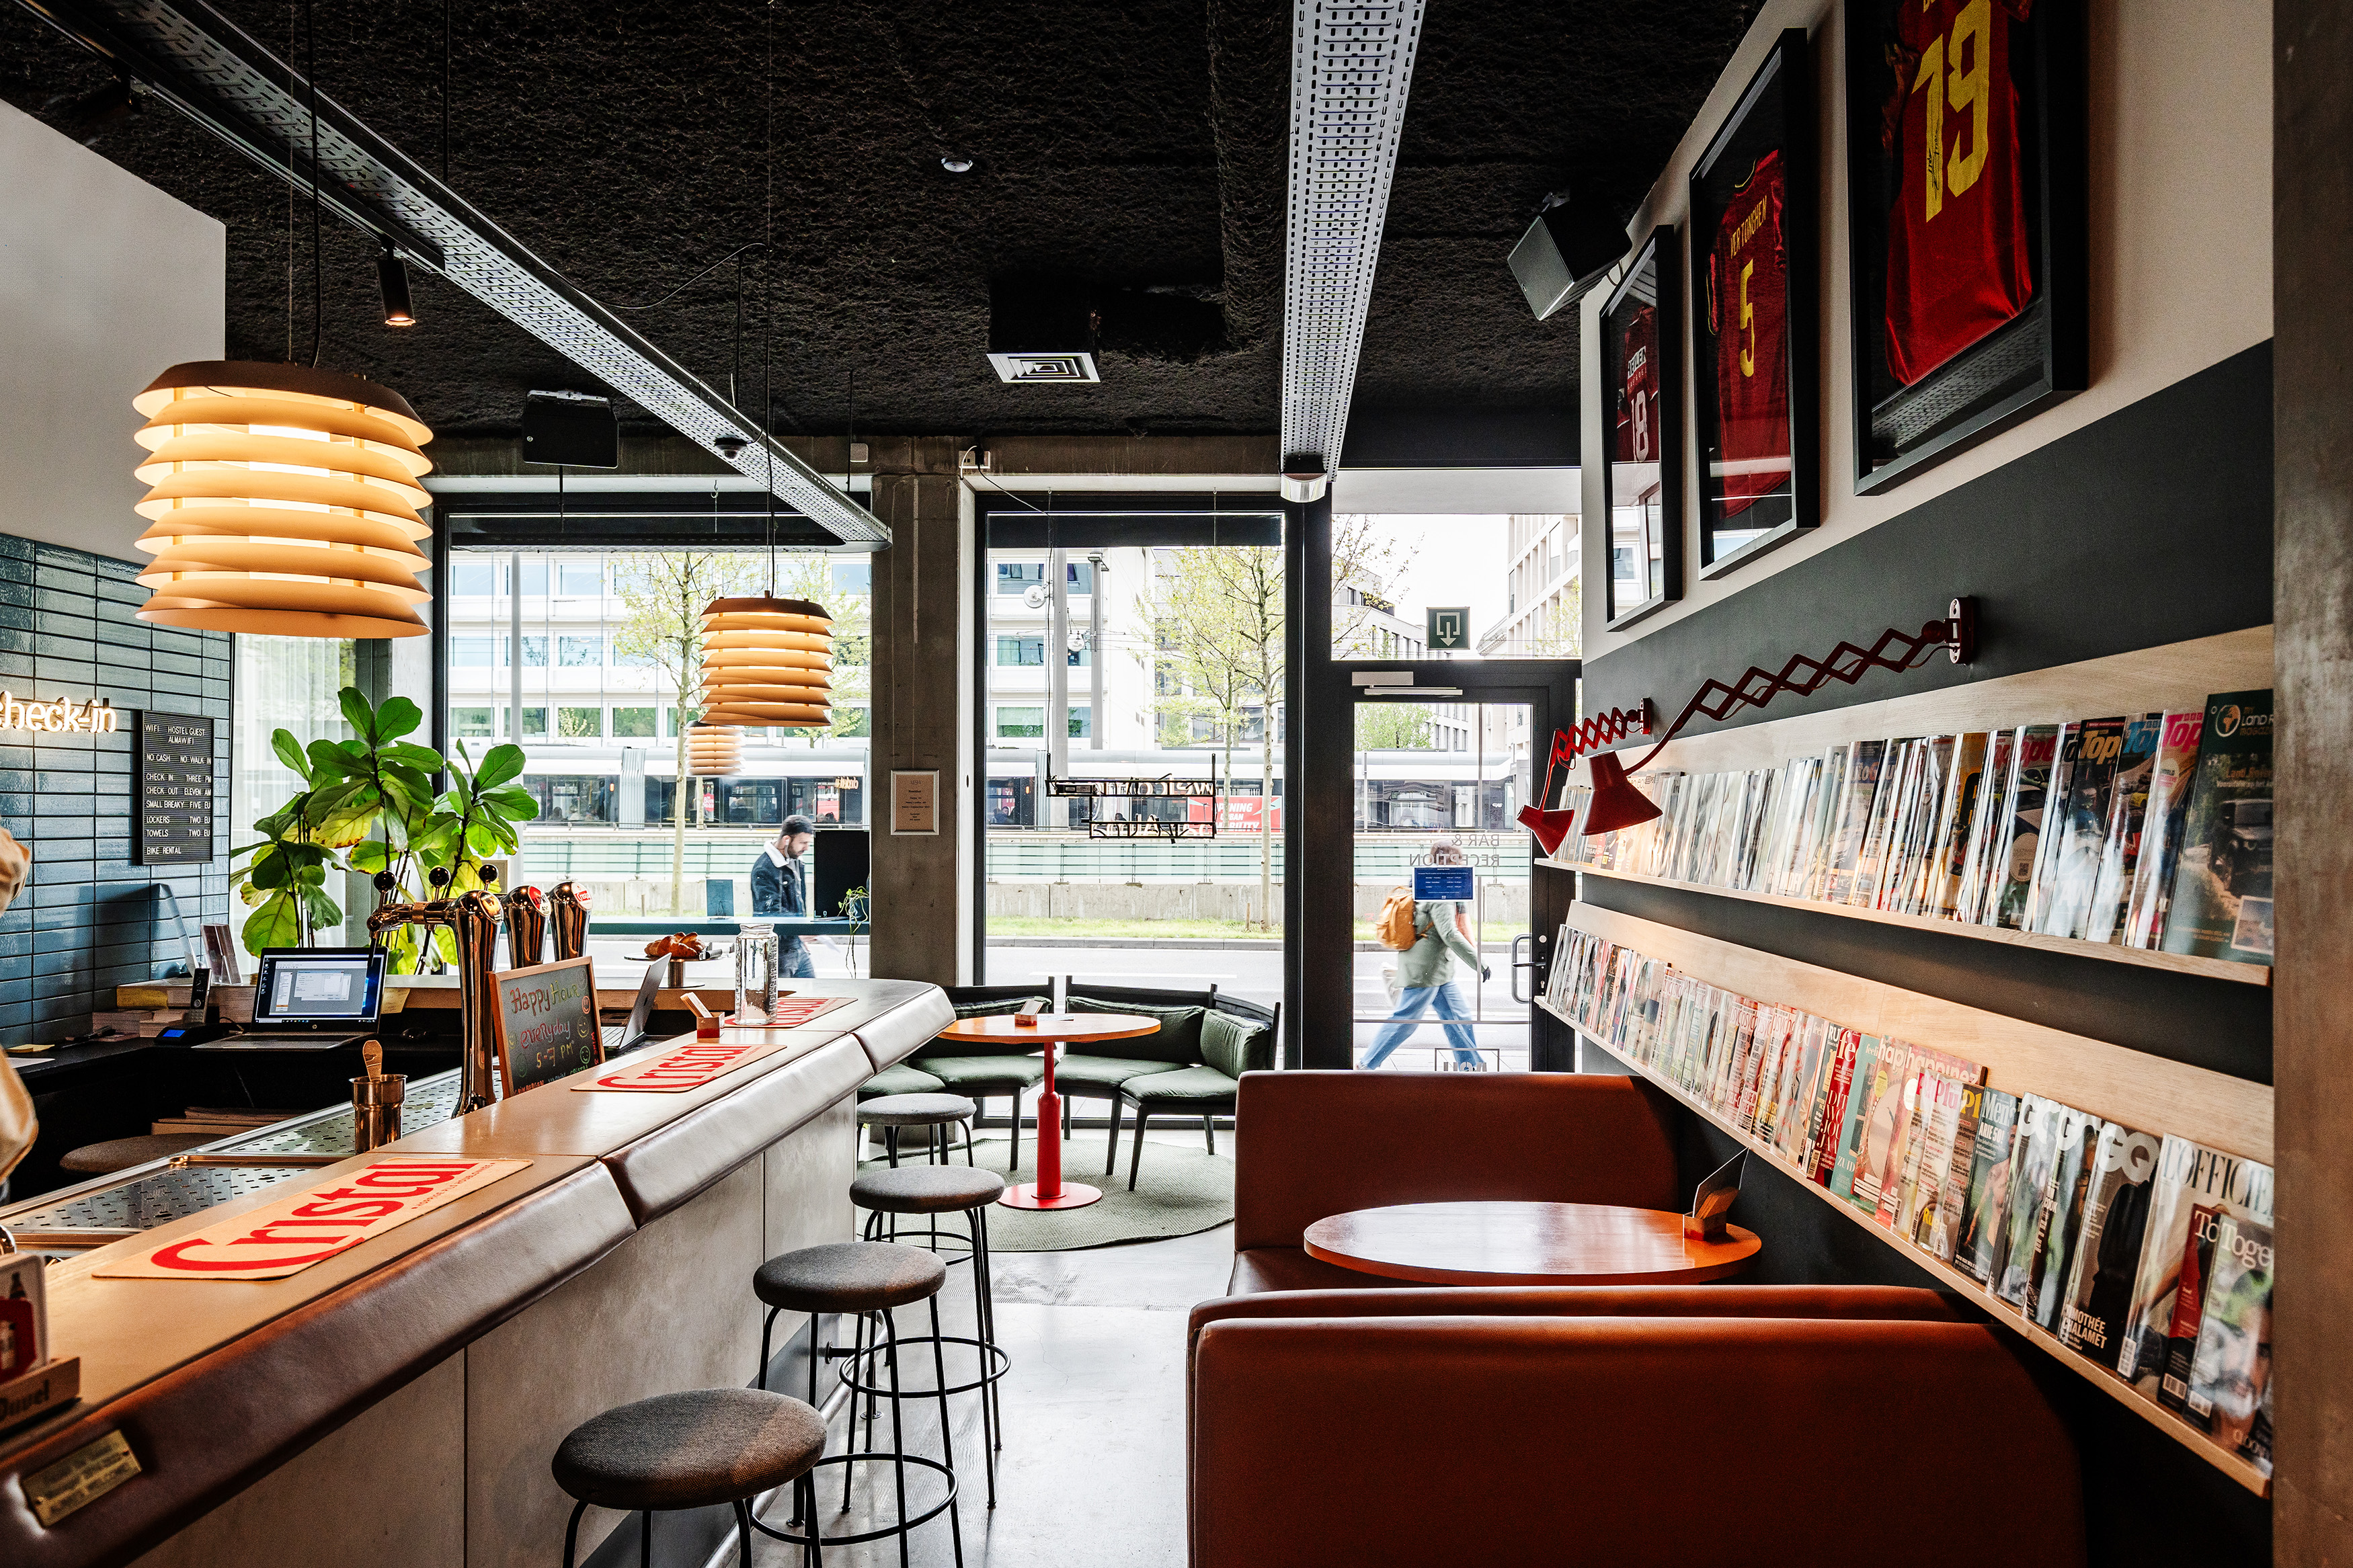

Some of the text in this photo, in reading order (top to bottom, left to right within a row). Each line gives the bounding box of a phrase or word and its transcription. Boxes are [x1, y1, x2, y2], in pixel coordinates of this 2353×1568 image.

[1911, 0, 1991, 222] 19
[1739, 258, 1755, 378] 5
[0, 690, 116, 733] heck-in
[145, 725, 205, 736] WIFI HOSTEL GUEST
[146, 753, 154, 761] NO
[190, 756, 204, 764] WALK
[206, 757, 211, 765] IN
[146, 773, 165, 781] CHECK
[168, 774, 173, 782] IN
[186, 774, 202, 782] THREE
[146, 786, 164, 794] CHECK
[167, 787, 177, 795] OUT
[184, 788, 201, 796] ELEVEN
[146, 800, 163, 809] SMALL
[189, 801, 201, 809] FIVE
[146, 816, 210, 824] LOCKERS TWO EU
[146, 829, 169, 837] TOWELS
[147, 846, 182, 855] BIKE RENTAL
[510, 987, 551, 1016] Happy
[560, 1042, 574, 1059] PM
[597, 1046, 752, 1089] Cristal
[2096, 1120, 2160, 1182] GQ
[150, 1162, 480, 1272] Cristal
